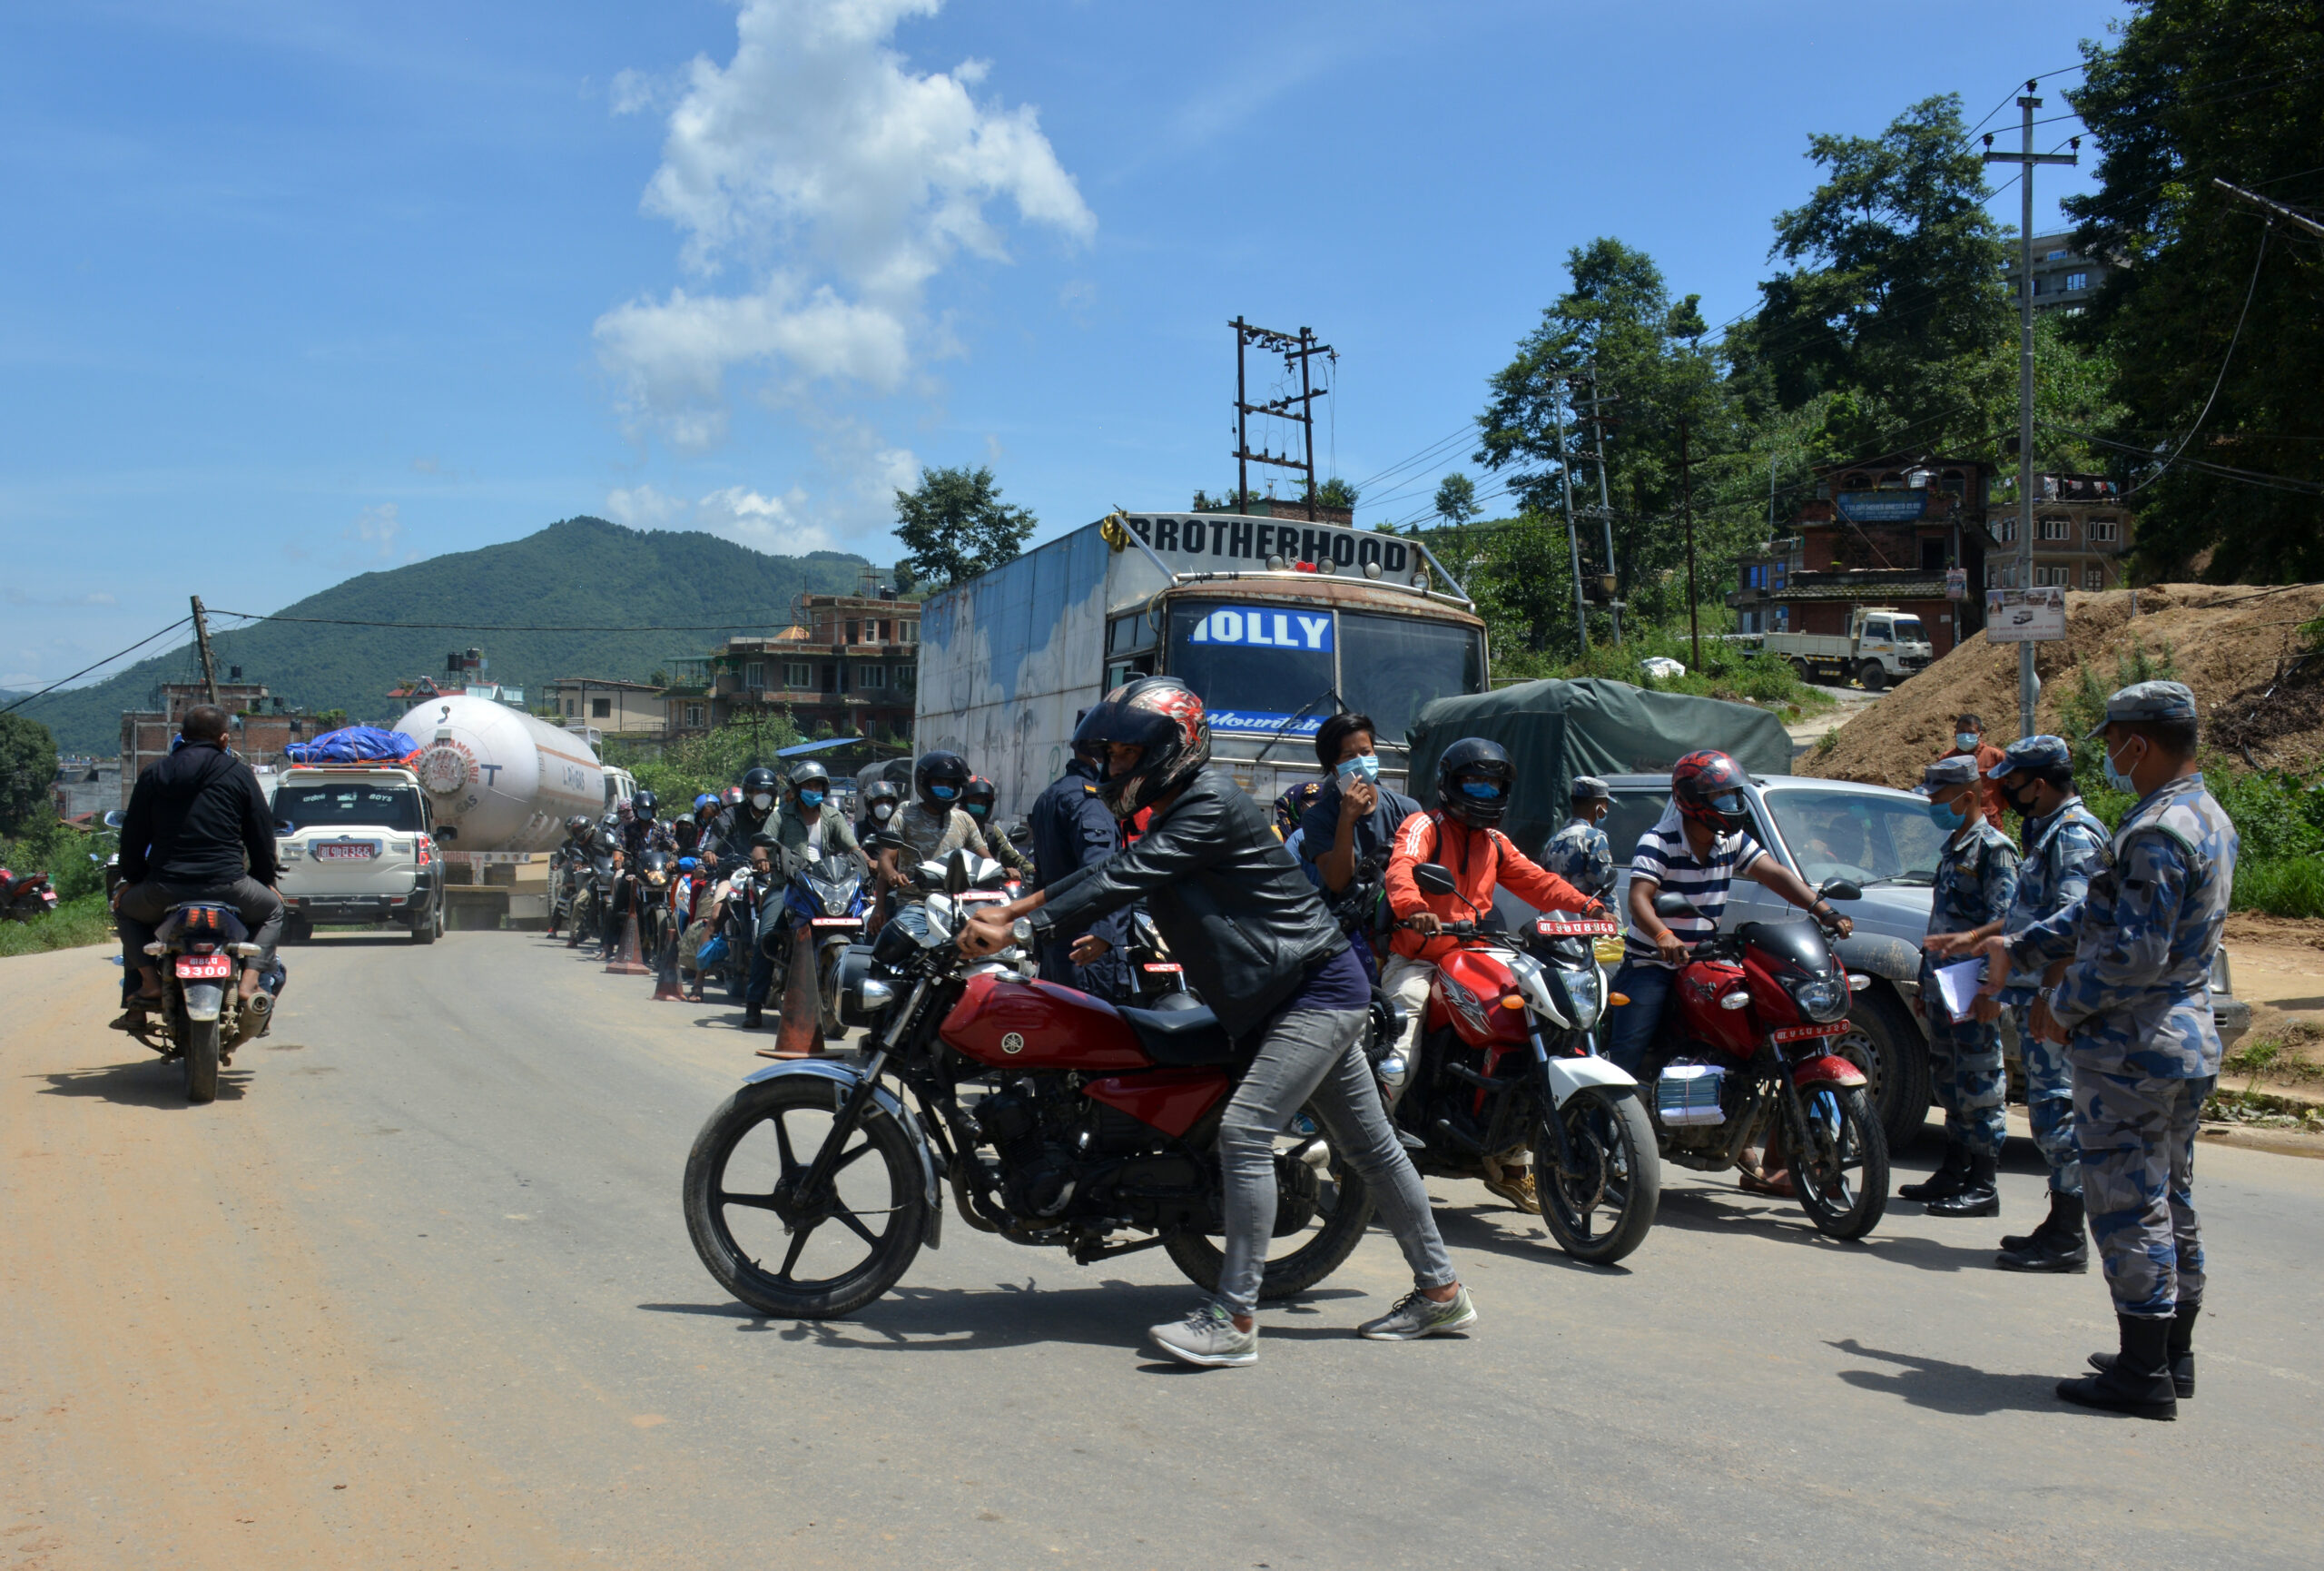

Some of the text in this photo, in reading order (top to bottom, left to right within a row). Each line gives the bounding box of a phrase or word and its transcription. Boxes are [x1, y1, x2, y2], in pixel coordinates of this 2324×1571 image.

[1128, 517, 1407, 573] BROTHERHOOD
[369, 793, 393, 803] BOYS
[456, 795, 478, 813] GAS
